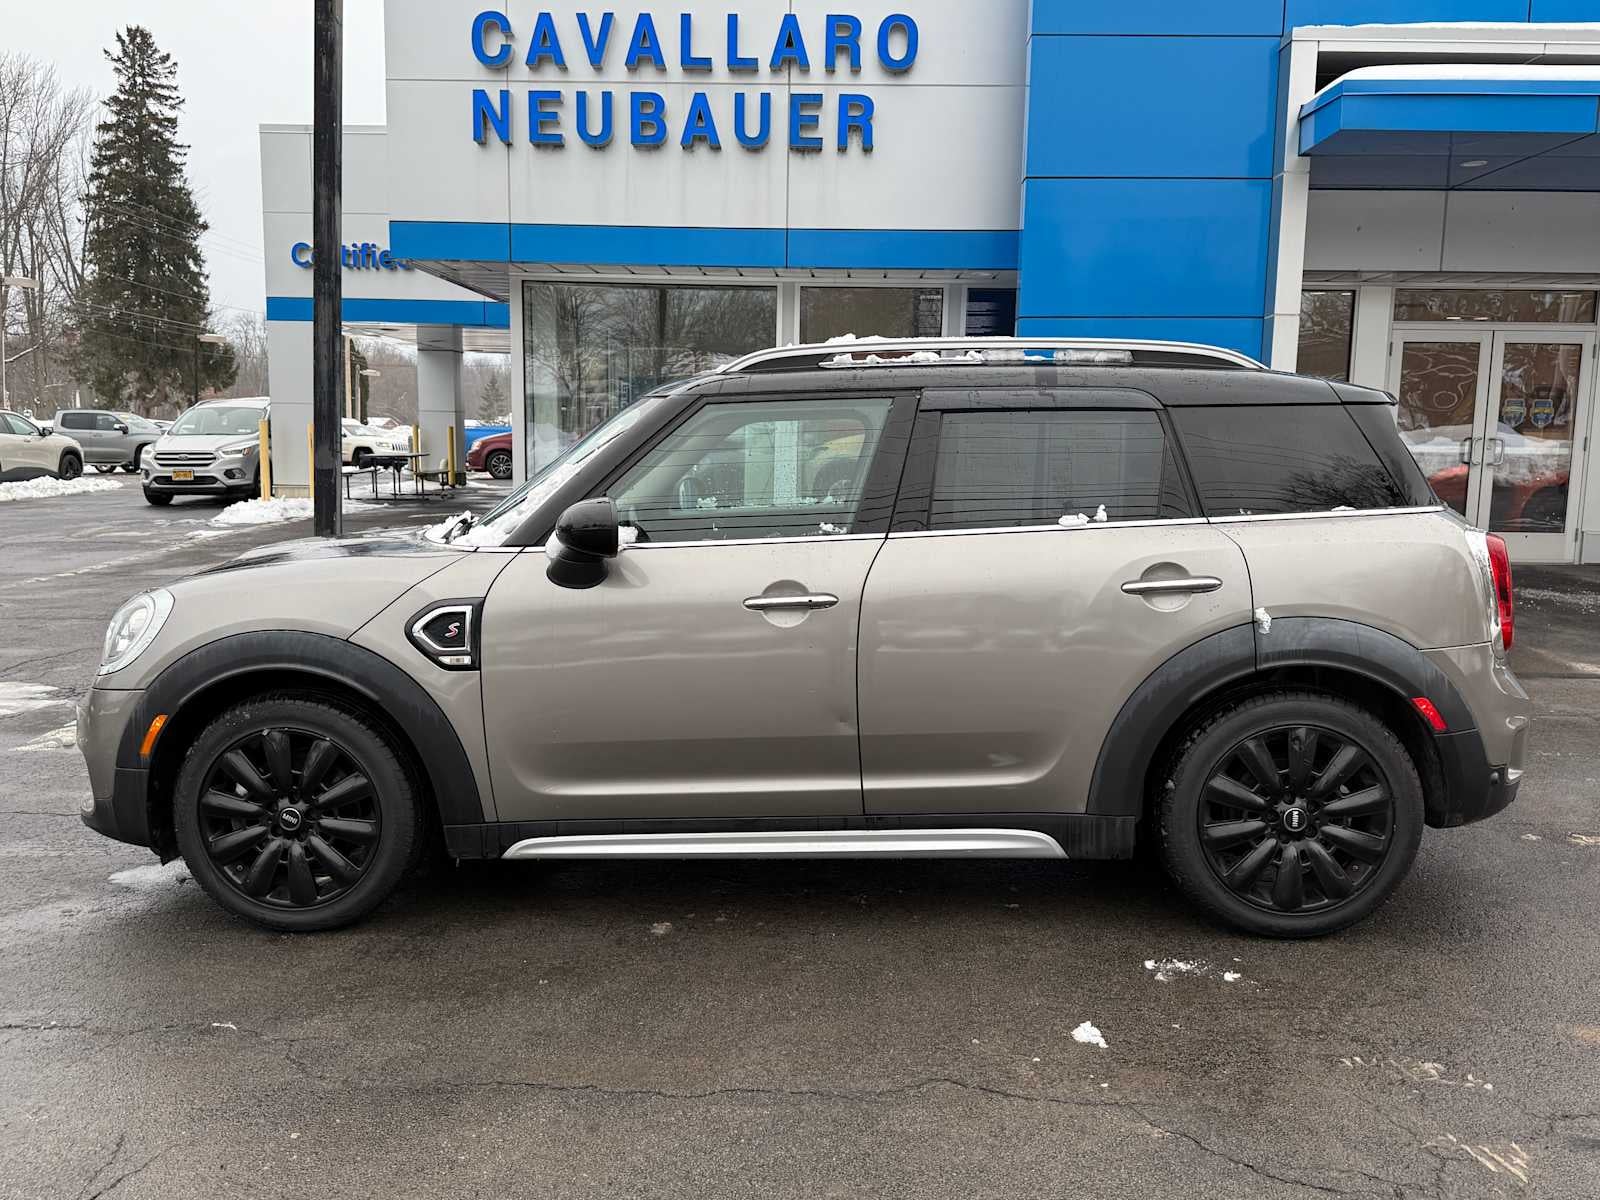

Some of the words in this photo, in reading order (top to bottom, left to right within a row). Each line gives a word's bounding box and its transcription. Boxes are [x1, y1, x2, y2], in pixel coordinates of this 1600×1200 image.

[471, 11, 919, 74] CAVALLARO
[472, 89, 875, 153] NEUBAUER
[291, 242, 413, 269] Ctifie
[445, 622, 460, 638] S
[282, 813, 297, 824] MINI
